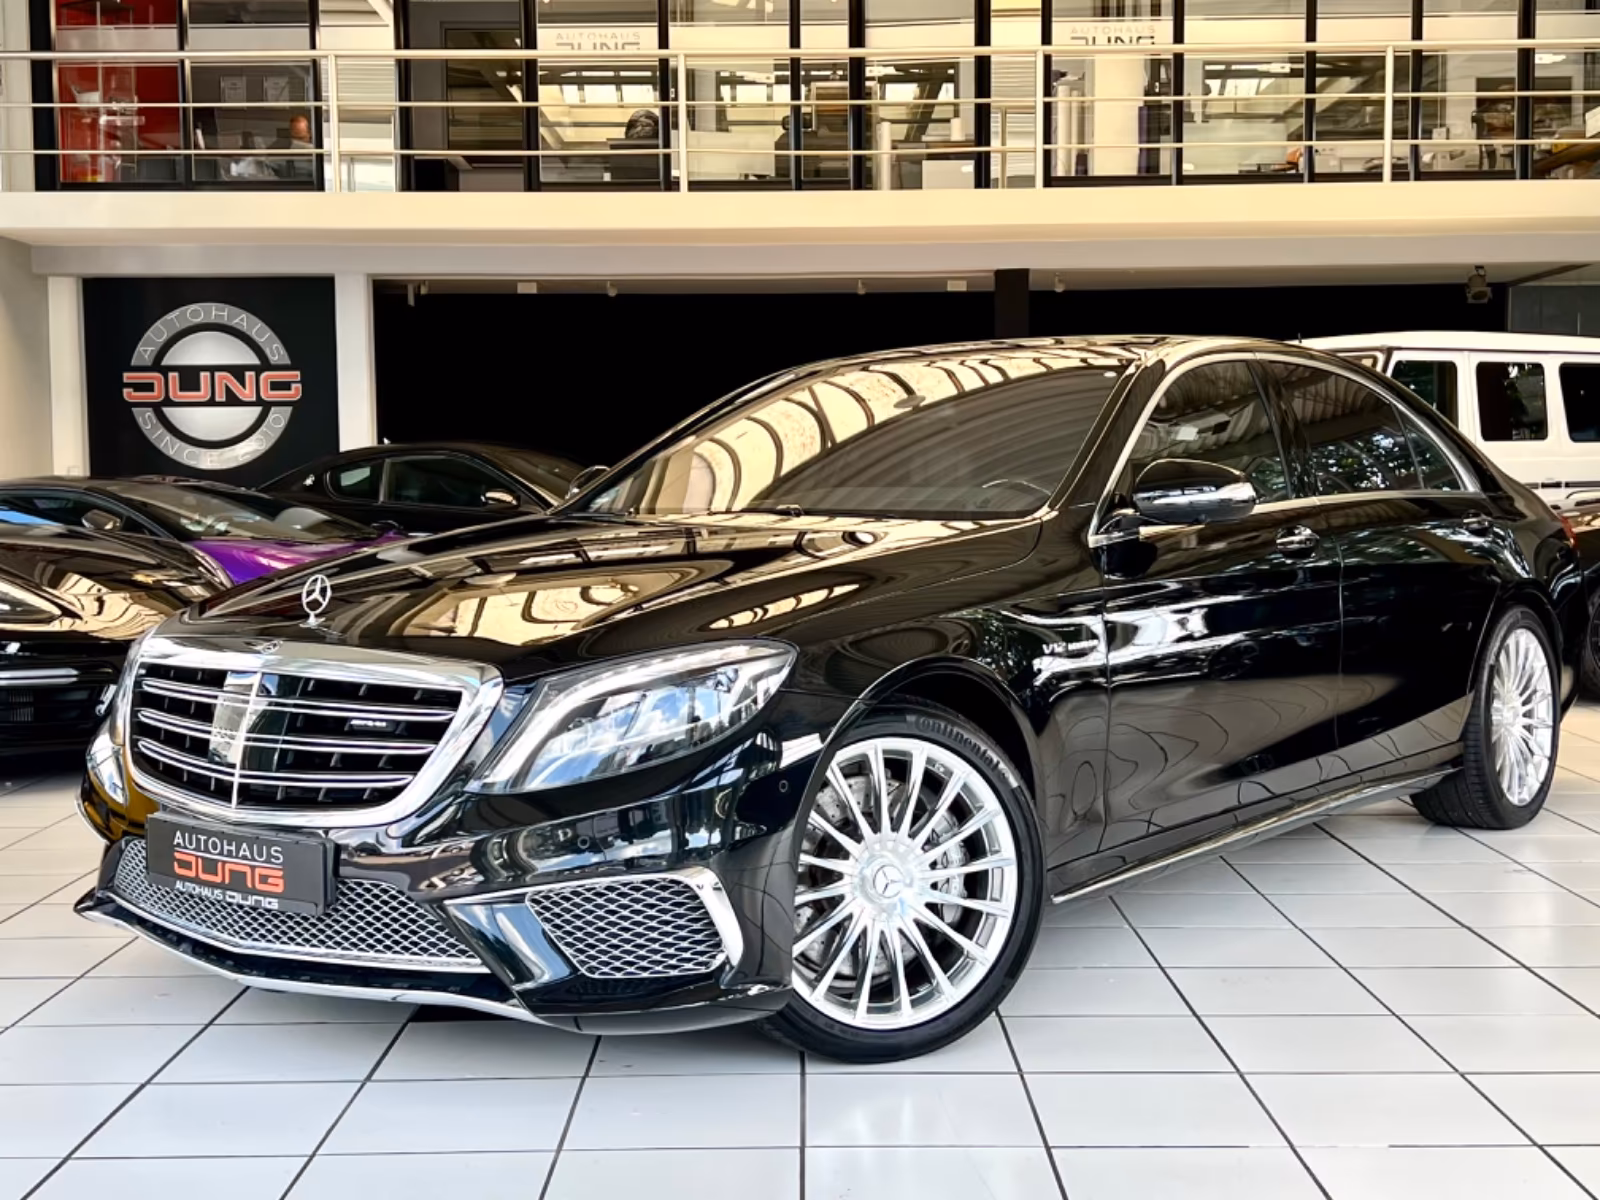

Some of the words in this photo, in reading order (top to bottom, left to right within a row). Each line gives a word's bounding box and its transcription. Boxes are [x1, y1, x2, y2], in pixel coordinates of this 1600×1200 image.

[555, 31, 641, 41] AUTOHAUS
[1070, 25, 1156, 35] AUTOHAUS
[139, 305, 284, 362] AUTOHAUS
[122, 371, 302, 402] JUNG
[139, 412, 219, 467] SINCE
[173, 830, 284, 863] AUTOHAUS
[173, 851, 285, 893] JUNG
[175, 880, 223, 900] AUTOHAUS
[225, 890, 279, 910] JUNG
